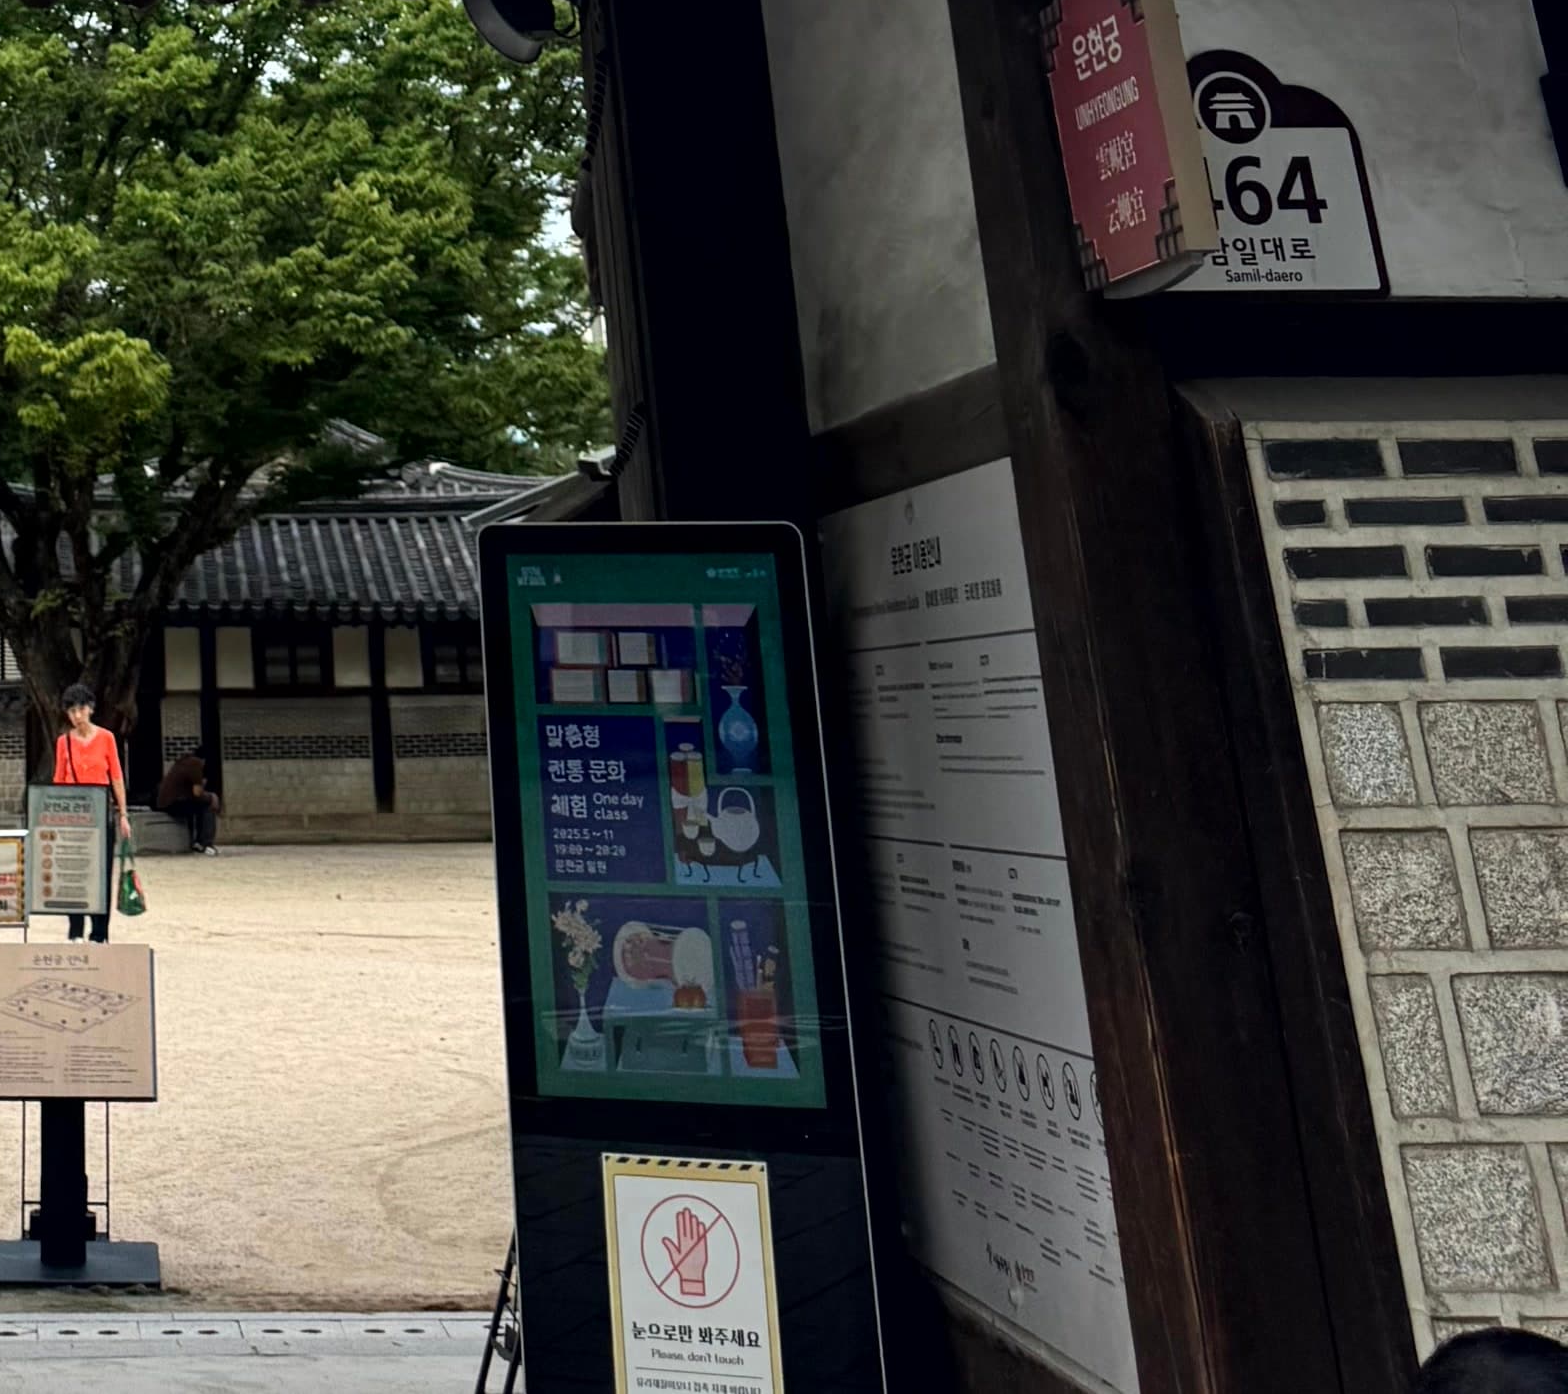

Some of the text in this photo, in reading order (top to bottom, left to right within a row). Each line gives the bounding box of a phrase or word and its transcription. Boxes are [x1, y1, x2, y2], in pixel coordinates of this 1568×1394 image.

[1072, 14, 1123, 82] 운현궁
[1074, 75, 1140, 131] UNHYEONGUNG
[1208, 155, 1328, 226] 64
[1225, 268, 1304, 283] Samil-daero
[547, 759, 627, 784] 전통 문화
[550, 793, 588, 819] 체험
[592, 792, 644, 809] One day
[594, 806, 629, 821] class
[633, 1322, 761, 1348] 눈으로만 봐주세요
[687, 1352, 712, 1363] don't
[715, 1353, 744, 1366] touch
